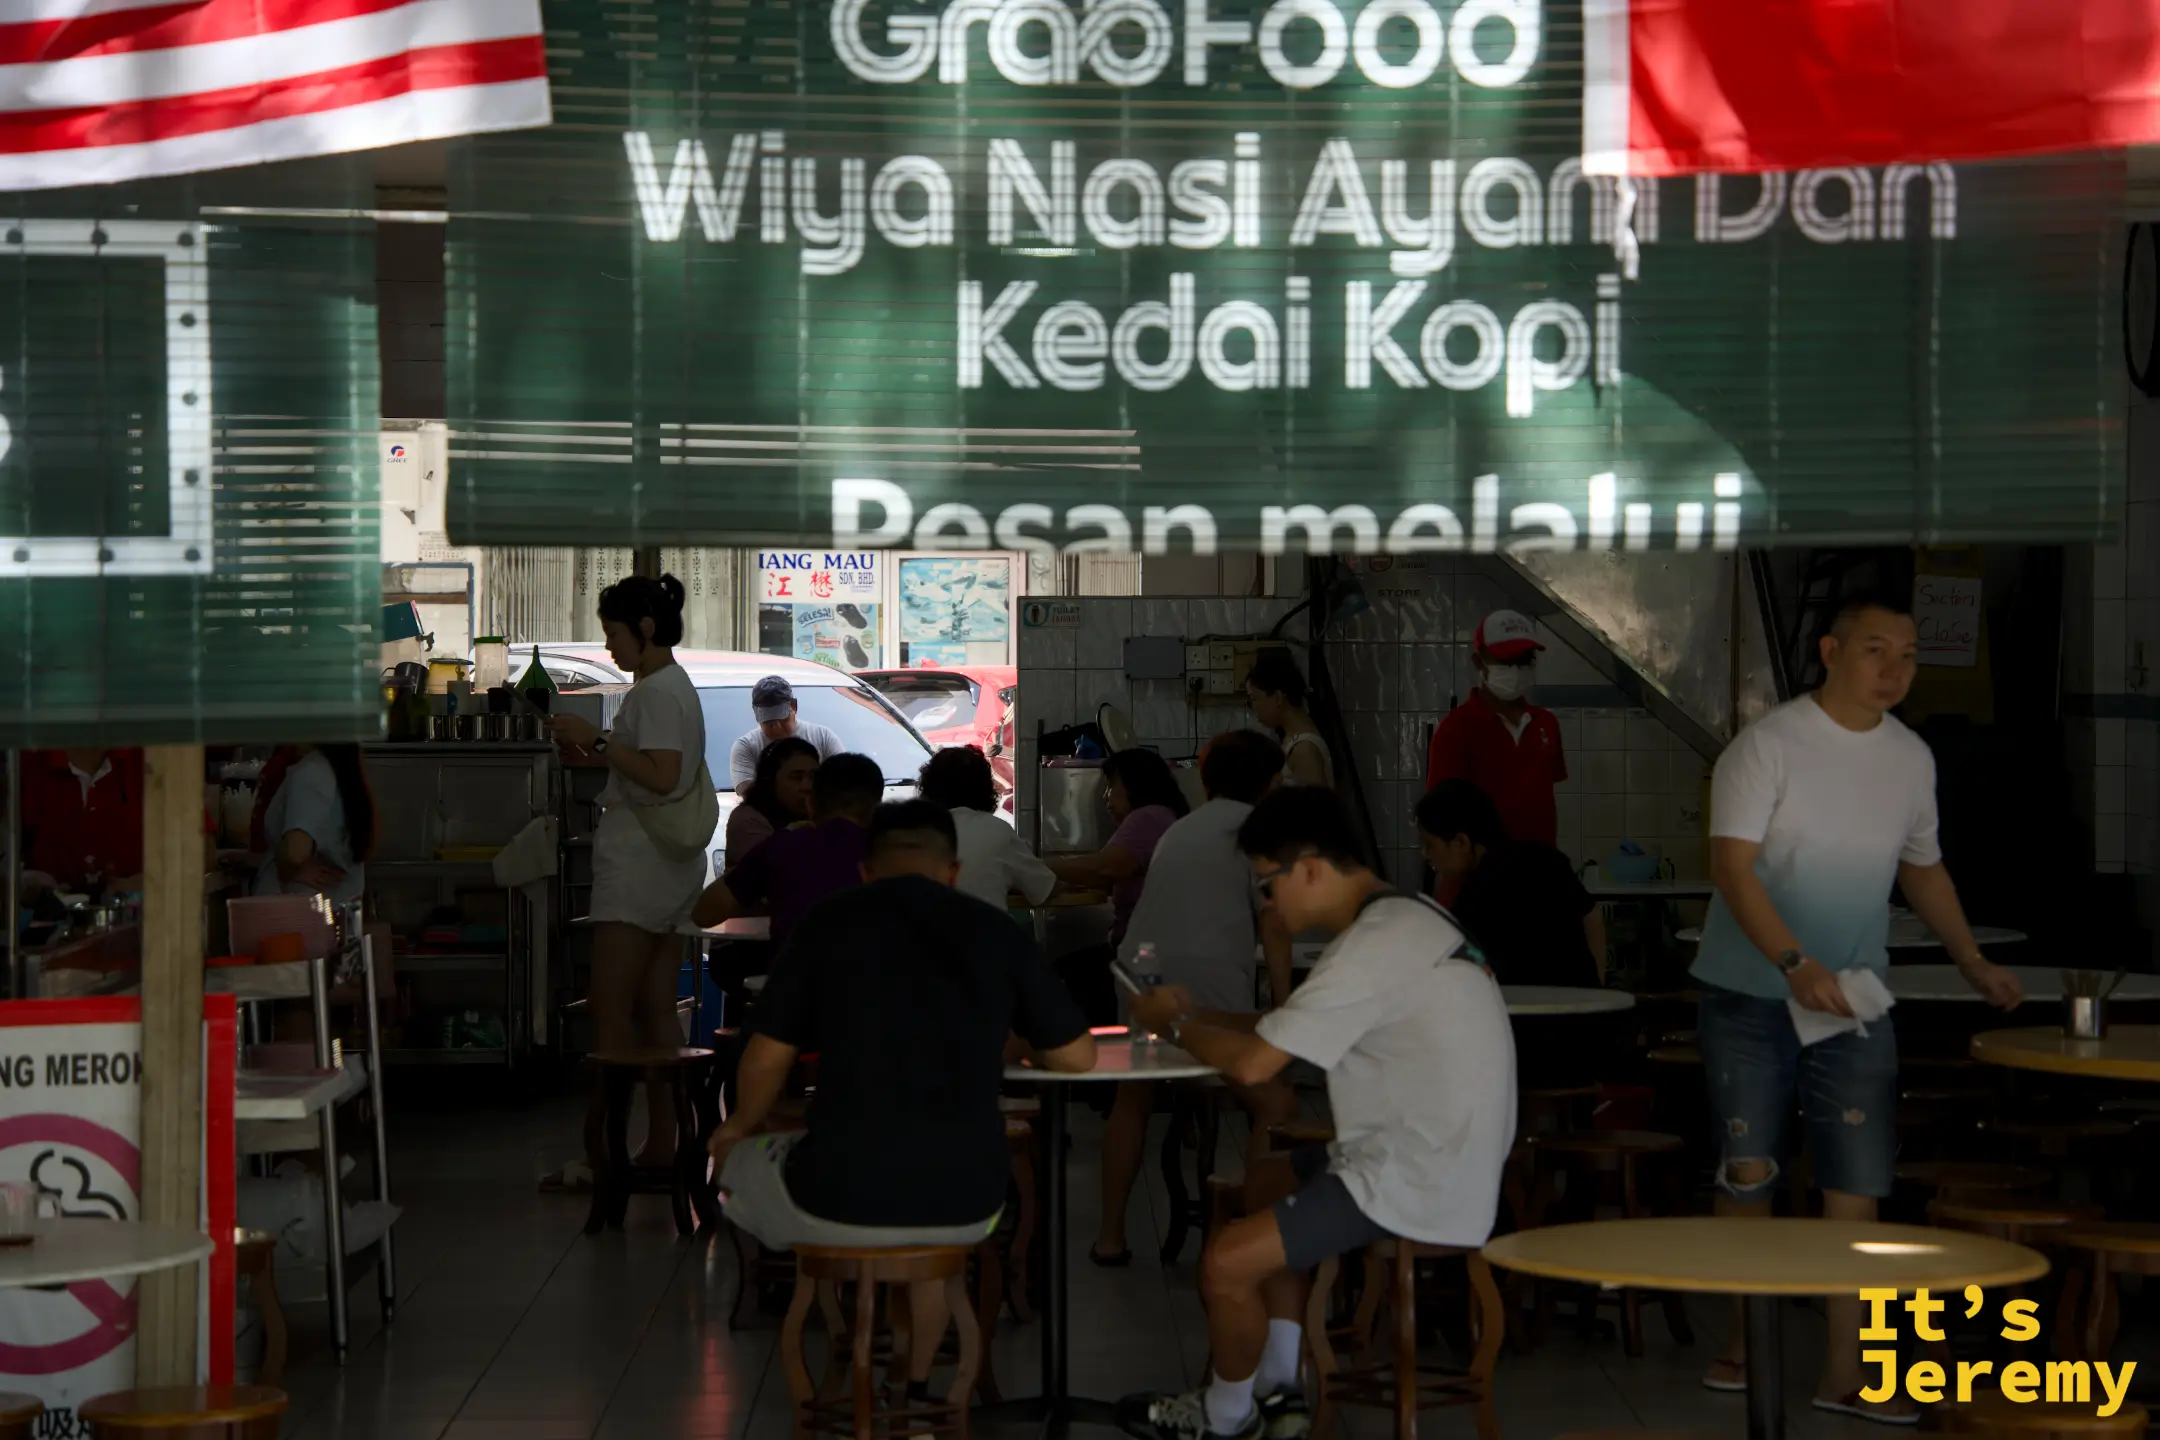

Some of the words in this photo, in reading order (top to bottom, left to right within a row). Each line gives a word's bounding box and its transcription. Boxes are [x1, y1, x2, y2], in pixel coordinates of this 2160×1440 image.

[623, 131, 954, 275] Wiya
[987, 132, 1261, 249] Nasi
[1694, 160, 1957, 243] Dan
[957, 272, 1310, 391] Kedai
[1345, 274, 1622, 418] Kopi
[831, 478, 1218, 556] Pesan
[1260, 472, 1742, 555] melalui
[824, 553, 875, 570] MAU
[1378, 588, 1421, 598] STORE
